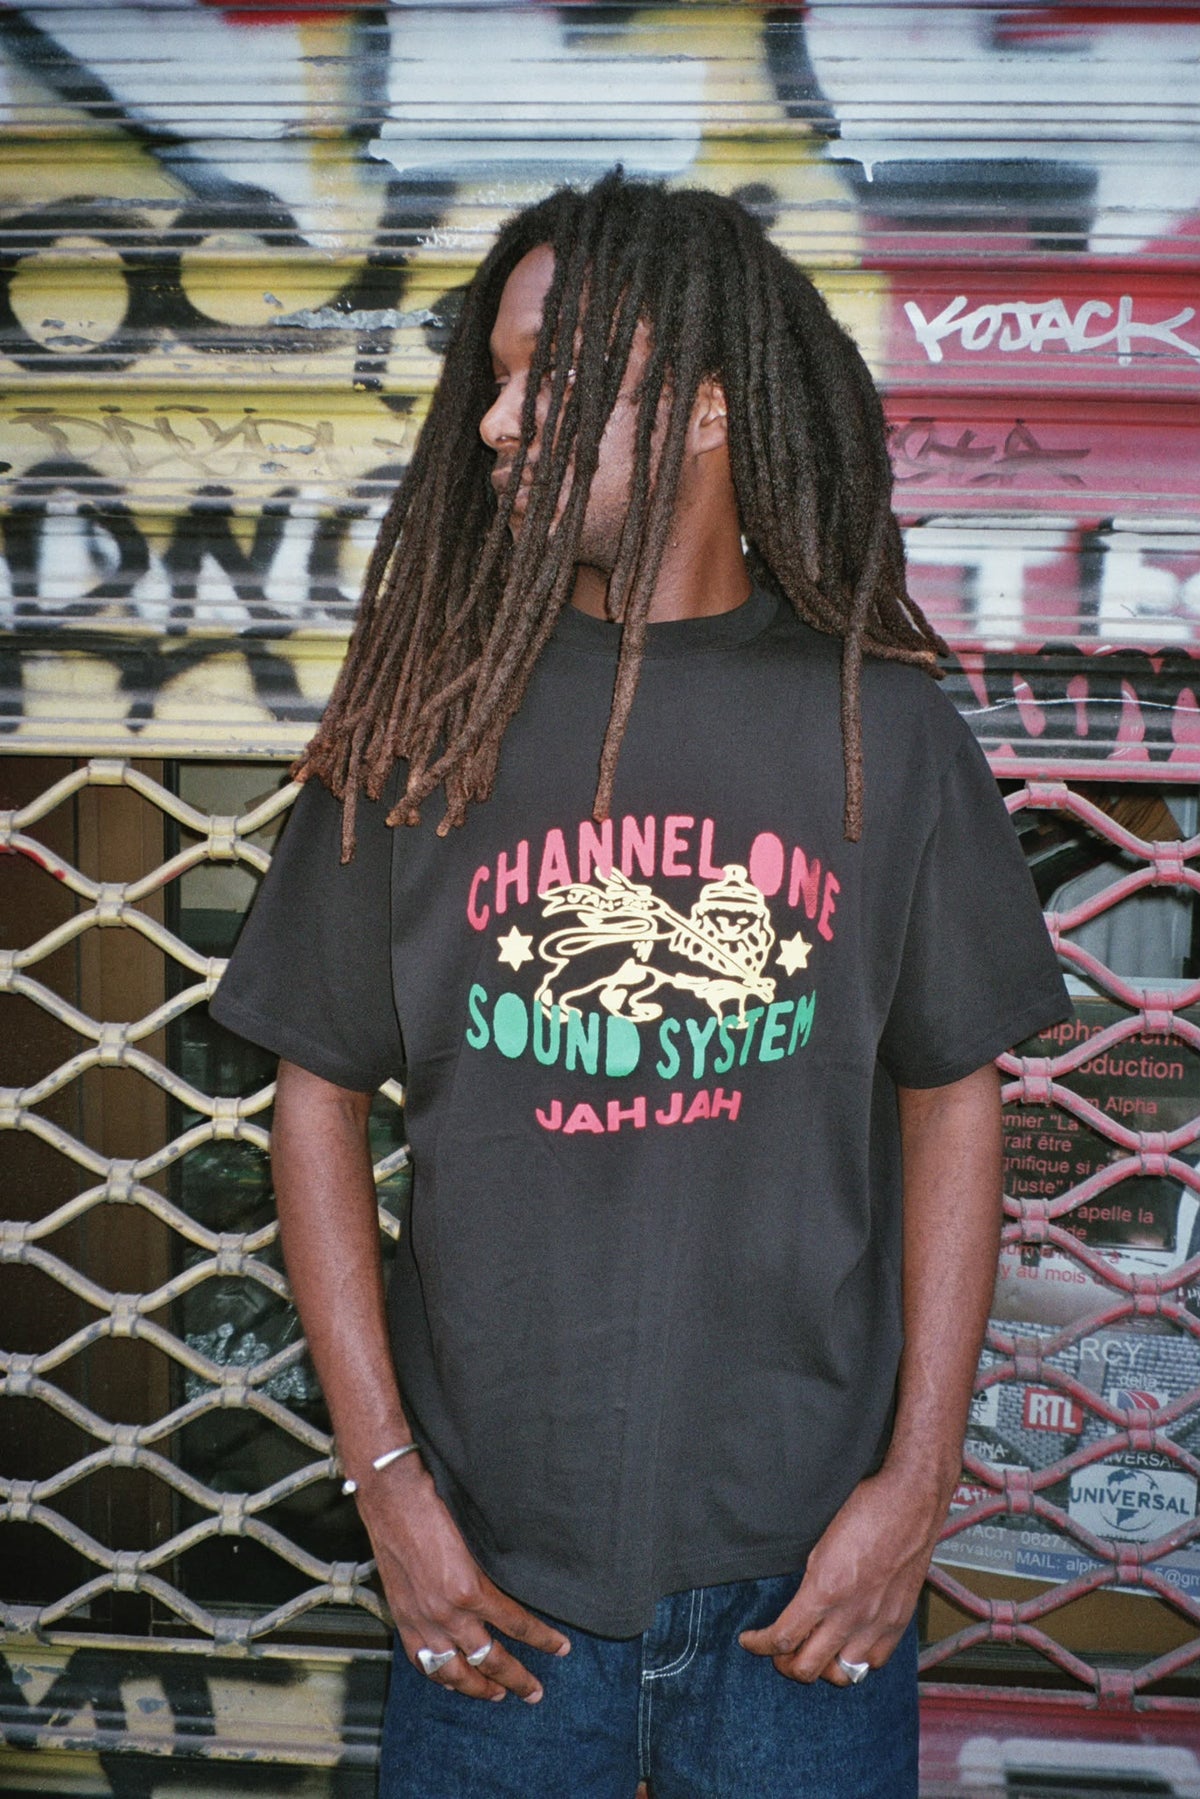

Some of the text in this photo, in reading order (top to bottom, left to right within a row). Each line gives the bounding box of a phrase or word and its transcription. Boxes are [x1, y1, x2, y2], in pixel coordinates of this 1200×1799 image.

[466, 815, 841, 941] CHANNEL ONE
[466, 983, 816, 1079] SOUND SYSTEM
[1068, 1056, 1184, 1080] oduction
[535, 1088, 742, 1133] JAH JAH
[1106, 1096, 1157, 1116] Alpha
[1037, 1135, 1072, 1152] être
[1076, 1162, 1091, 1174] si
[1078, 1206, 1155, 1224] apelle la
[1016, 1267, 1039, 1280] au
[1045, 1268, 1086, 1284] mois
[1029, 1393, 1076, 1429] RTL
[1071, 1486, 1190, 1515] UNIVERSAL
